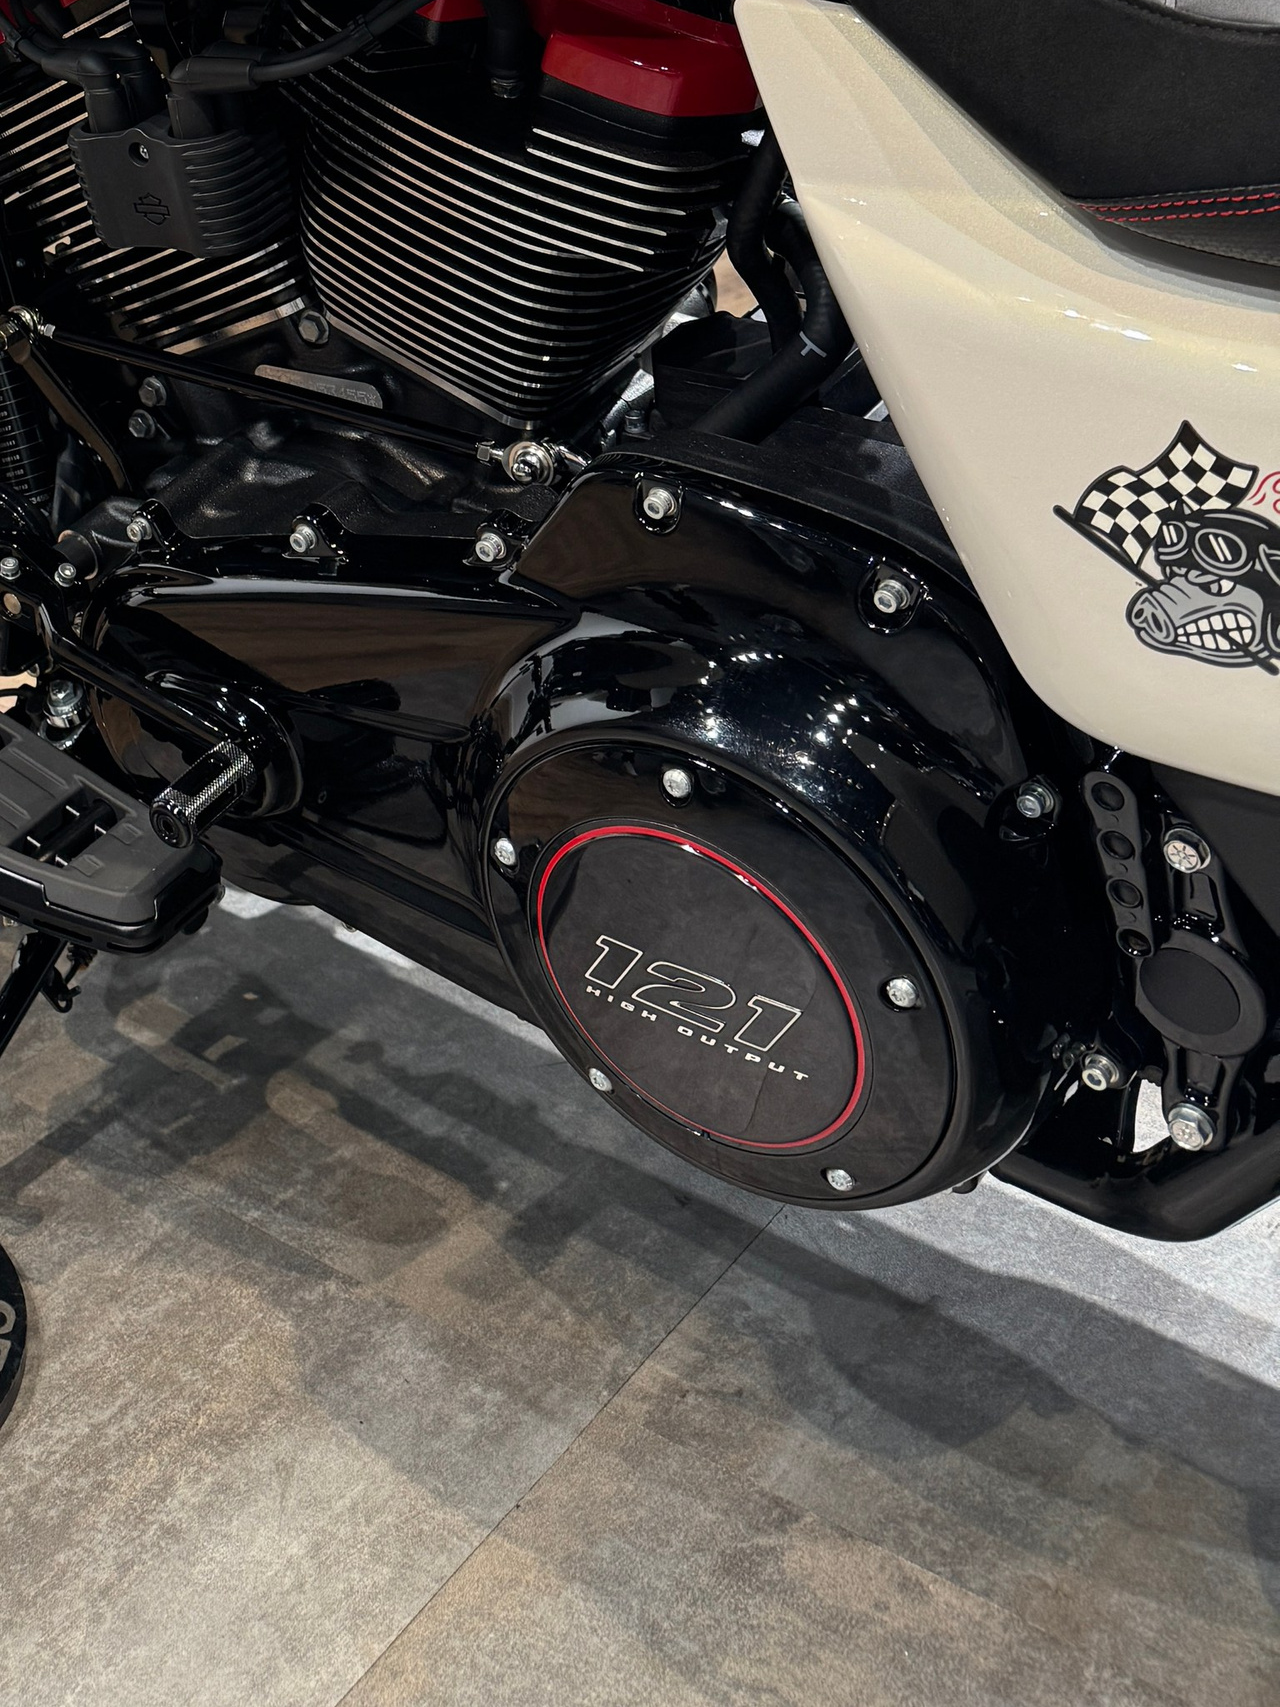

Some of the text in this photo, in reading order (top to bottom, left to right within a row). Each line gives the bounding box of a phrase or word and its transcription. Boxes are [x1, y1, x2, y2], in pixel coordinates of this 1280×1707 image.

[584, 934, 804, 1053] 121
[585, 984, 810, 1082] HIGH OUTPUT
